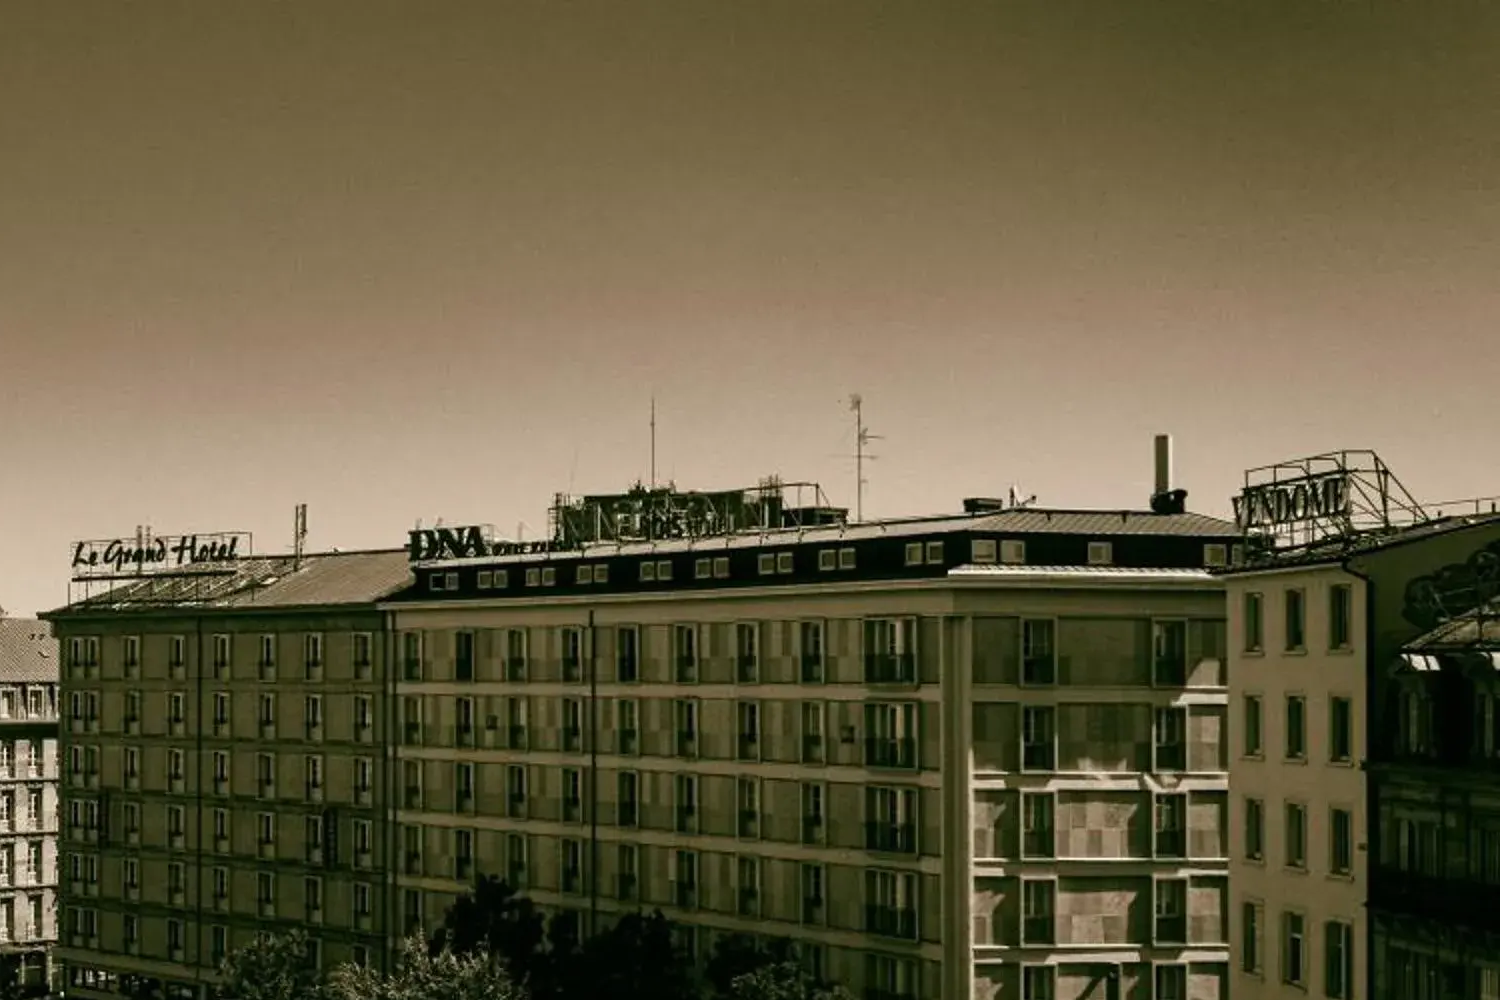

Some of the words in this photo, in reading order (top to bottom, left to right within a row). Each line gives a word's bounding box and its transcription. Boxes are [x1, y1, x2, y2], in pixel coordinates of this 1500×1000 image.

[72, 541, 98, 567] Le
[104, 538, 166, 571] Grand
[172, 535, 239, 564] Hotel
[407, 525, 487, 561] DNA
